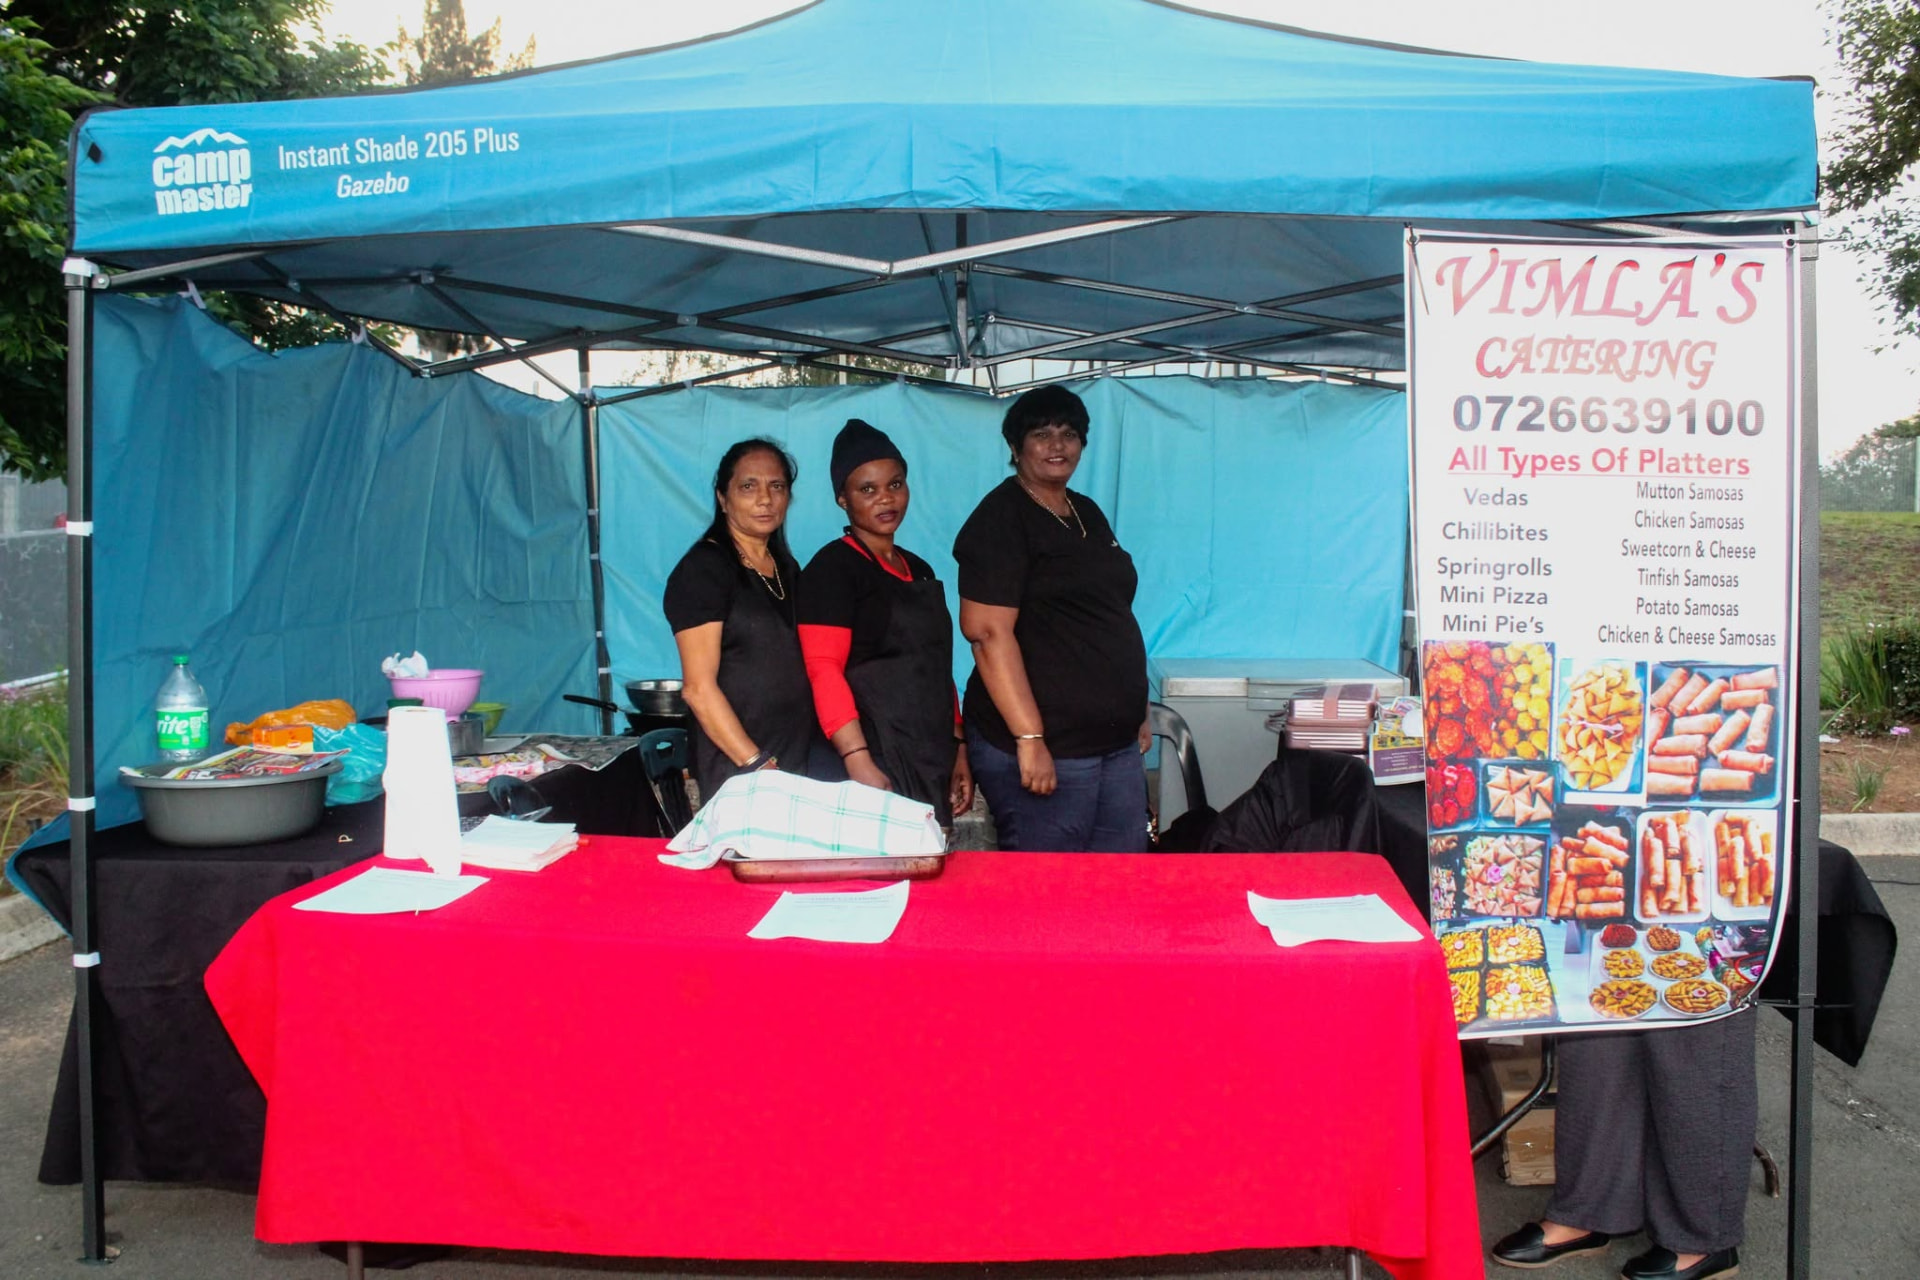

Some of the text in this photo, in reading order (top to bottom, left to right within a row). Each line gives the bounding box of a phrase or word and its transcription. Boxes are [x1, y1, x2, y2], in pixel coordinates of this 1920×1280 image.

[278, 127, 520, 170] Instant Shade 205 Plus
[152, 147, 252, 188] camp
[336, 172, 410, 199] Gazebo
[155, 183, 253, 215] master
[1435, 247, 1766, 327] VIMLA'S
[1475, 333, 1717, 390] CATERING
[1452, 395, 1765, 437] 0726639100
[1448, 446, 1751, 478] All Types Of Platters
[1463, 487, 1529, 507] Vedas
[1636, 481, 1744, 502] Mutton Samosas
[1634, 509, 1745, 531] Chicken Samosas
[1442, 522, 1549, 542] Chillibites
[1621, 538, 1757, 560] Sweetcorn & Cheese
[1437, 556, 1553, 581] Springrolls
[1637, 567, 1740, 588] Tinfish Samosas
[1440, 585, 1549, 606] Mini Pizza
[1636, 597, 1739, 617] Potato Samosas
[1442, 614, 1545, 634] Mini Pie's
[1597, 624, 1777, 647] Chicken & Cheese Samosas
